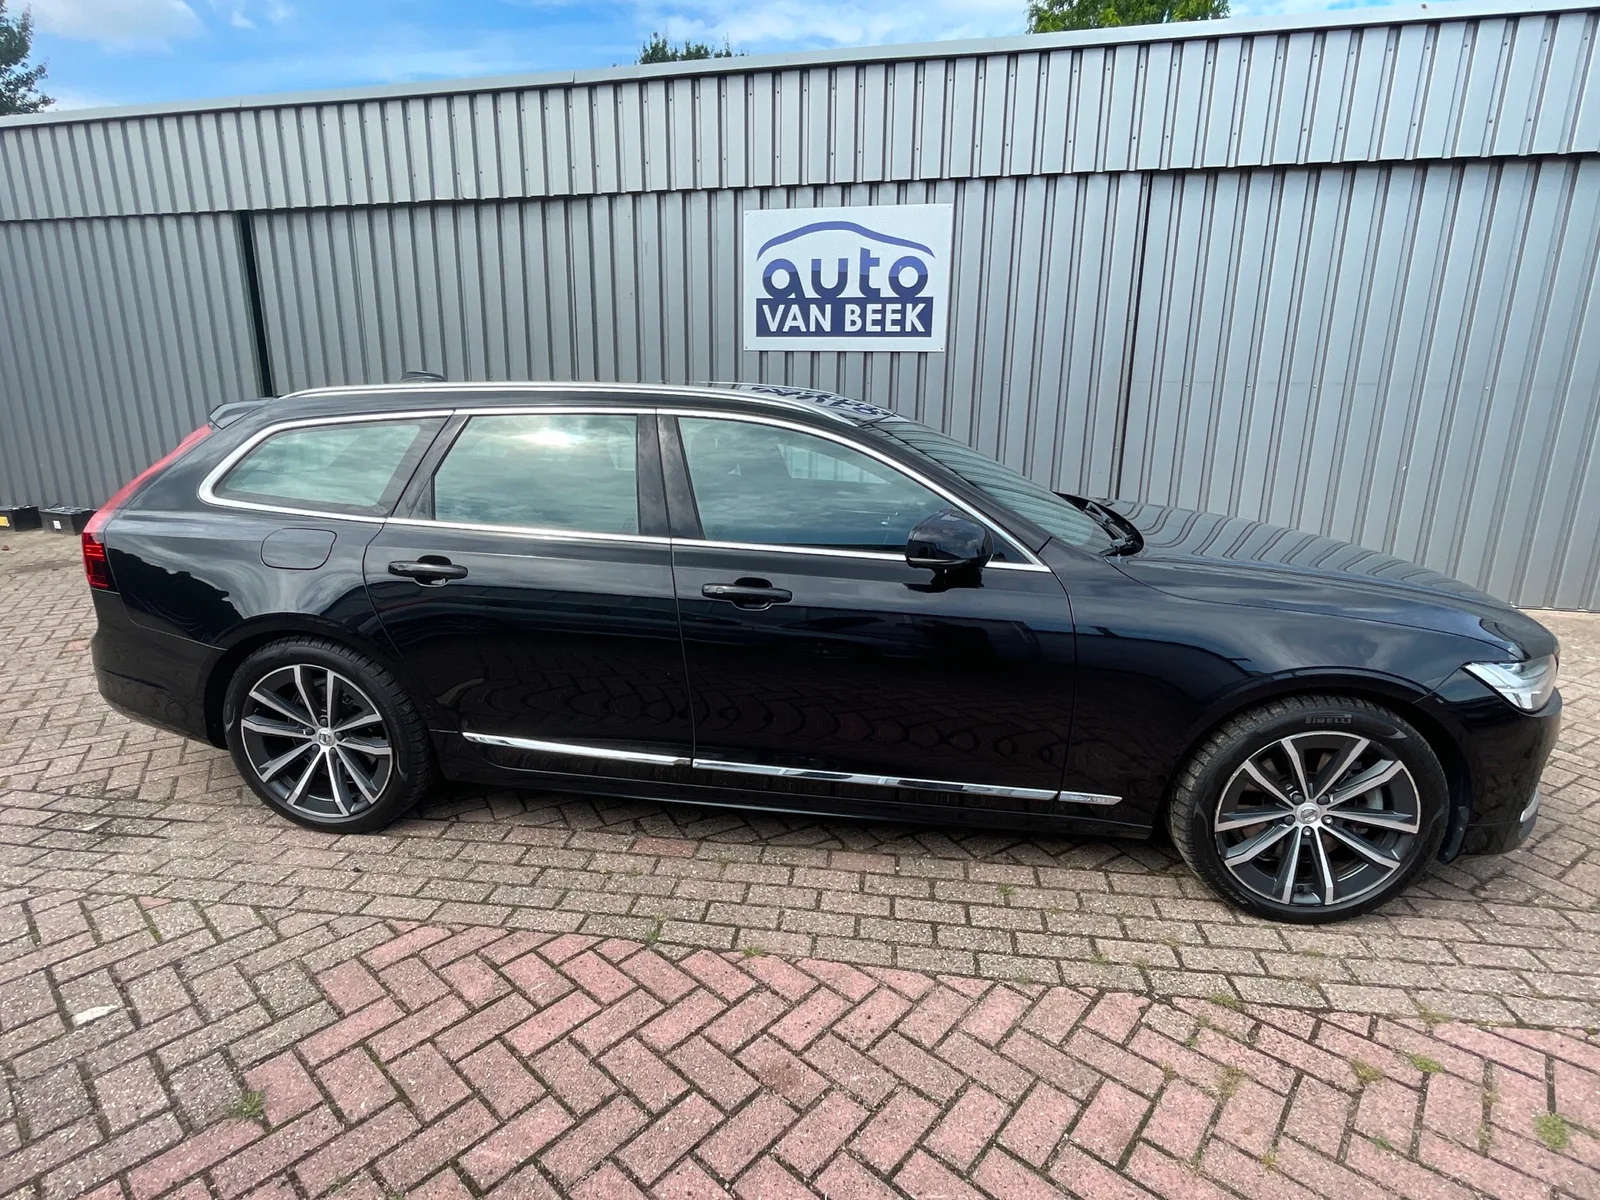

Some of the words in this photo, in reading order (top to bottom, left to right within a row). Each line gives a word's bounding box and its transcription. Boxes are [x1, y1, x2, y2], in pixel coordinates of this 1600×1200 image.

[762, 247, 929, 299] auto
[762, 304, 832, 332] VAN
[844, 303, 926, 332] BEEK
[1305, 713, 1352, 724] PIRELLI
